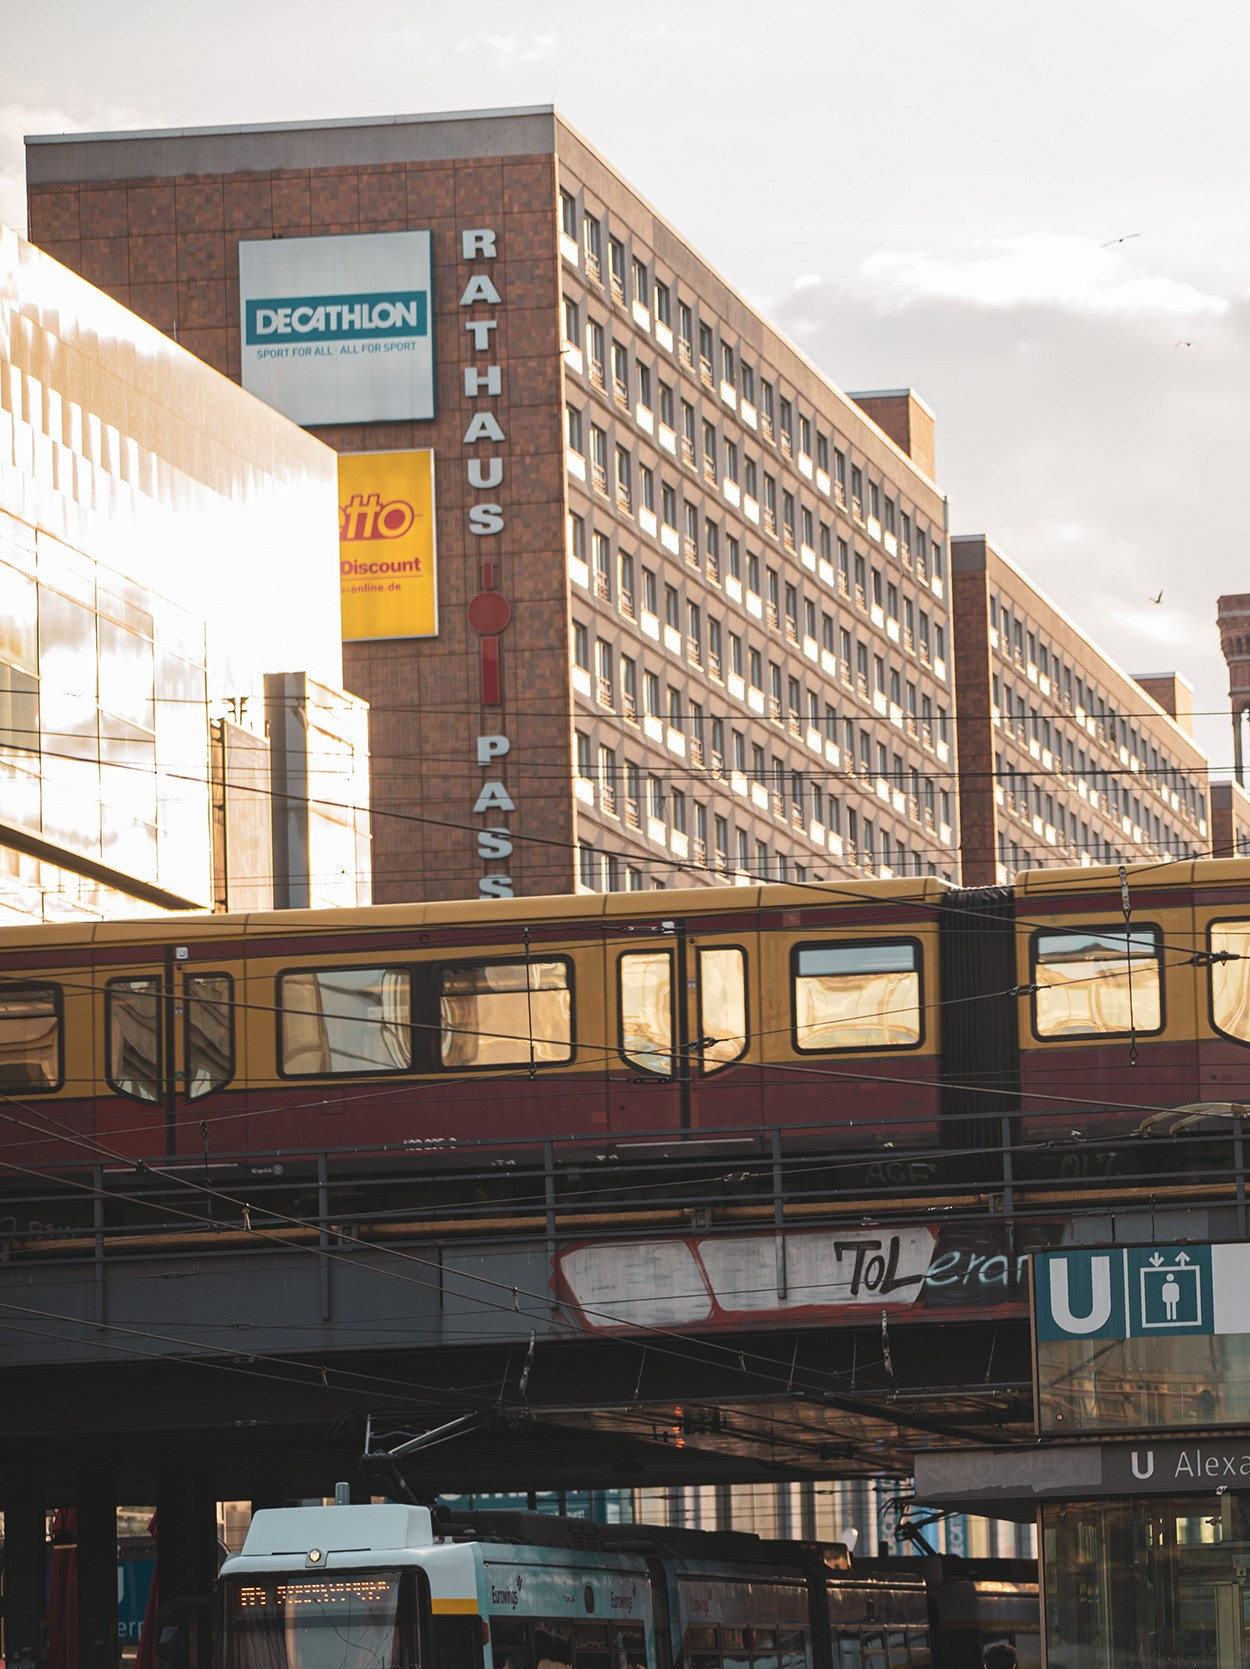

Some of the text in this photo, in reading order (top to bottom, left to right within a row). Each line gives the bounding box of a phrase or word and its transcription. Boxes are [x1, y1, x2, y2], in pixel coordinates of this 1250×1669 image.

[256, 301, 417, 335] DECATHLON
[257, 341, 417, 360] SPORT FOR ALL ALL FOR SPORT
[460, 229, 506, 535] RATHAUS
[1049, 1255, 1112, 1335] U
[1131, 1450, 1155, 1480] U
[491, 1585, 518, 1610] Eurowings
